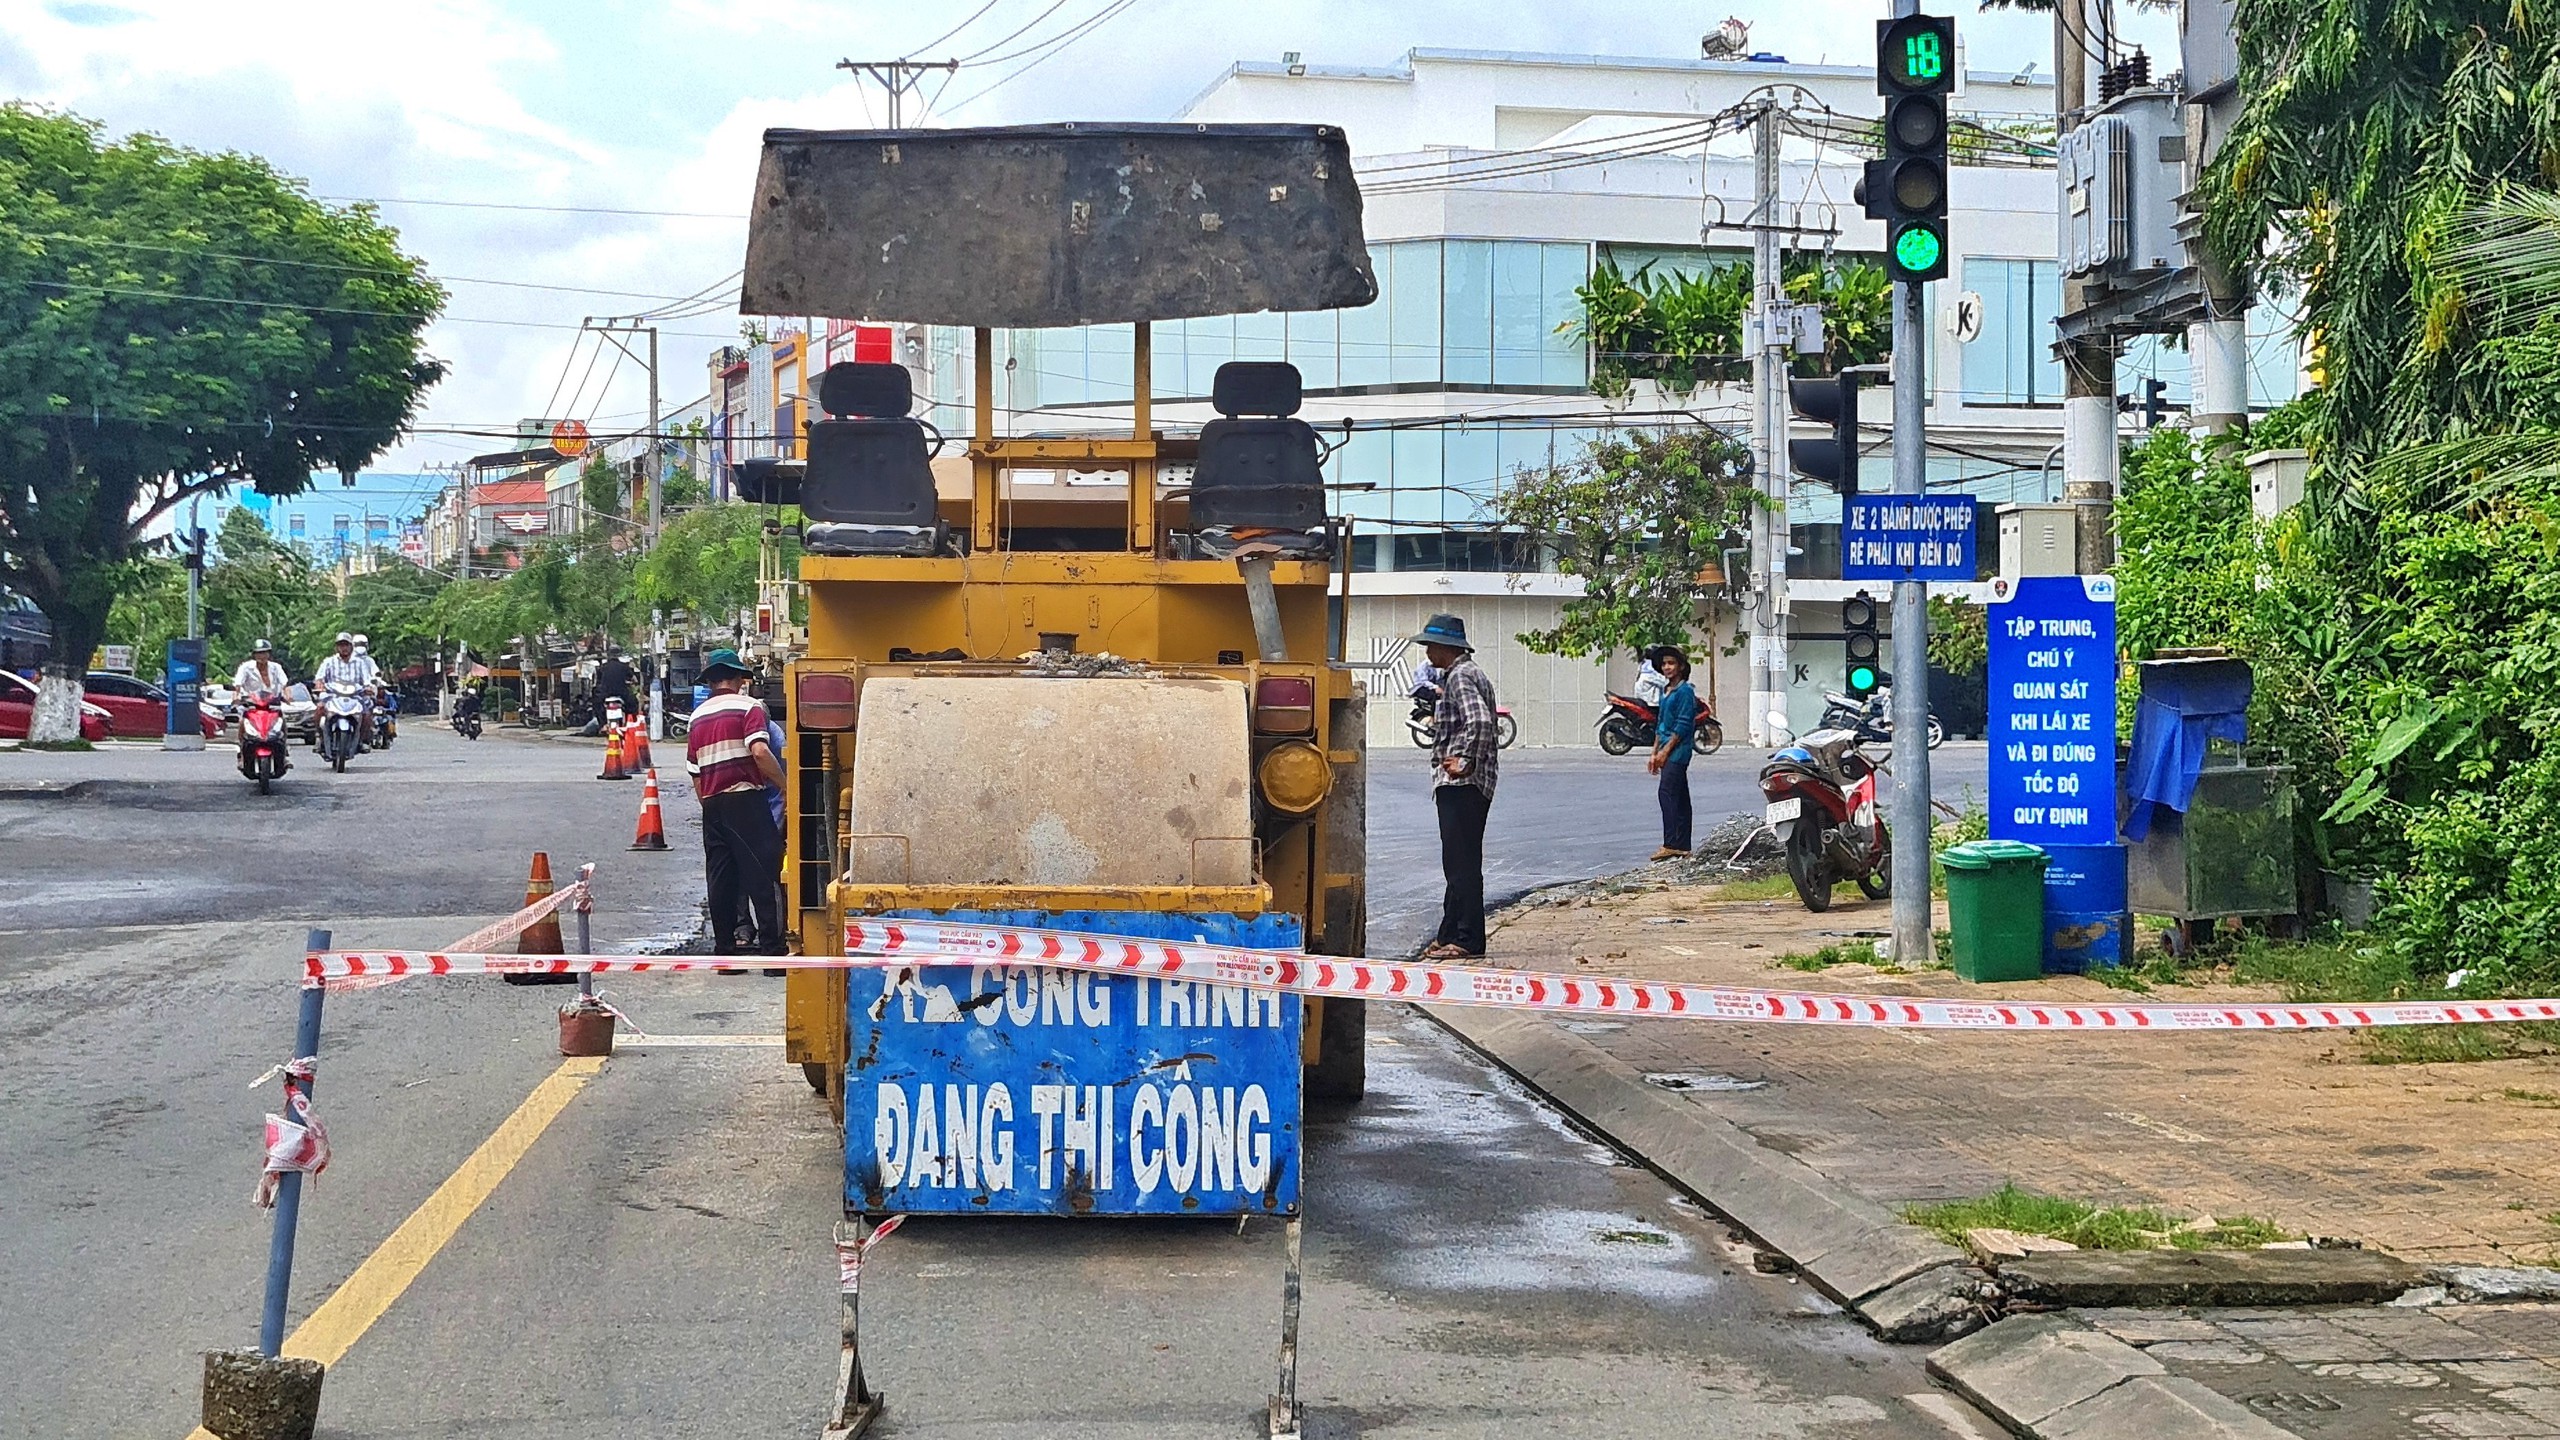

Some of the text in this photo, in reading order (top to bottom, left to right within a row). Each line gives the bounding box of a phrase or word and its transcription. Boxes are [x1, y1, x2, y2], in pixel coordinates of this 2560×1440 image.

[1907, 31, 1941, 78] 18
[1851, 507, 1866, 530] XE
[1870, 506, 1877, 530] 2
[1881, 501, 1911, 531] BÁNH
[1943, 501, 1972, 531] PHÉP
[1866, 533, 1892, 565] PHẢI
[1896, 542, 1915, 566] KHI
[1919, 538, 1942, 565] ĐÈN
[2005, 616, 2097, 640] TẬP TRUNG,
[2027, 647, 2075, 668] CHÚ Ý
[2013, 678, 2089, 699] QUAN SÁT
[2011, 710, 2091, 731] KHI LÁI XE
[2006, 741, 2096, 762] VÀ ĐI ĐÚNG
[2023, 769, 2079, 797] TỐC ĐỘ
[2014, 807, 2088, 828] QUY ĐỊNH
[875, 1060, 1271, 1194] ĐANG THI CÔNG
